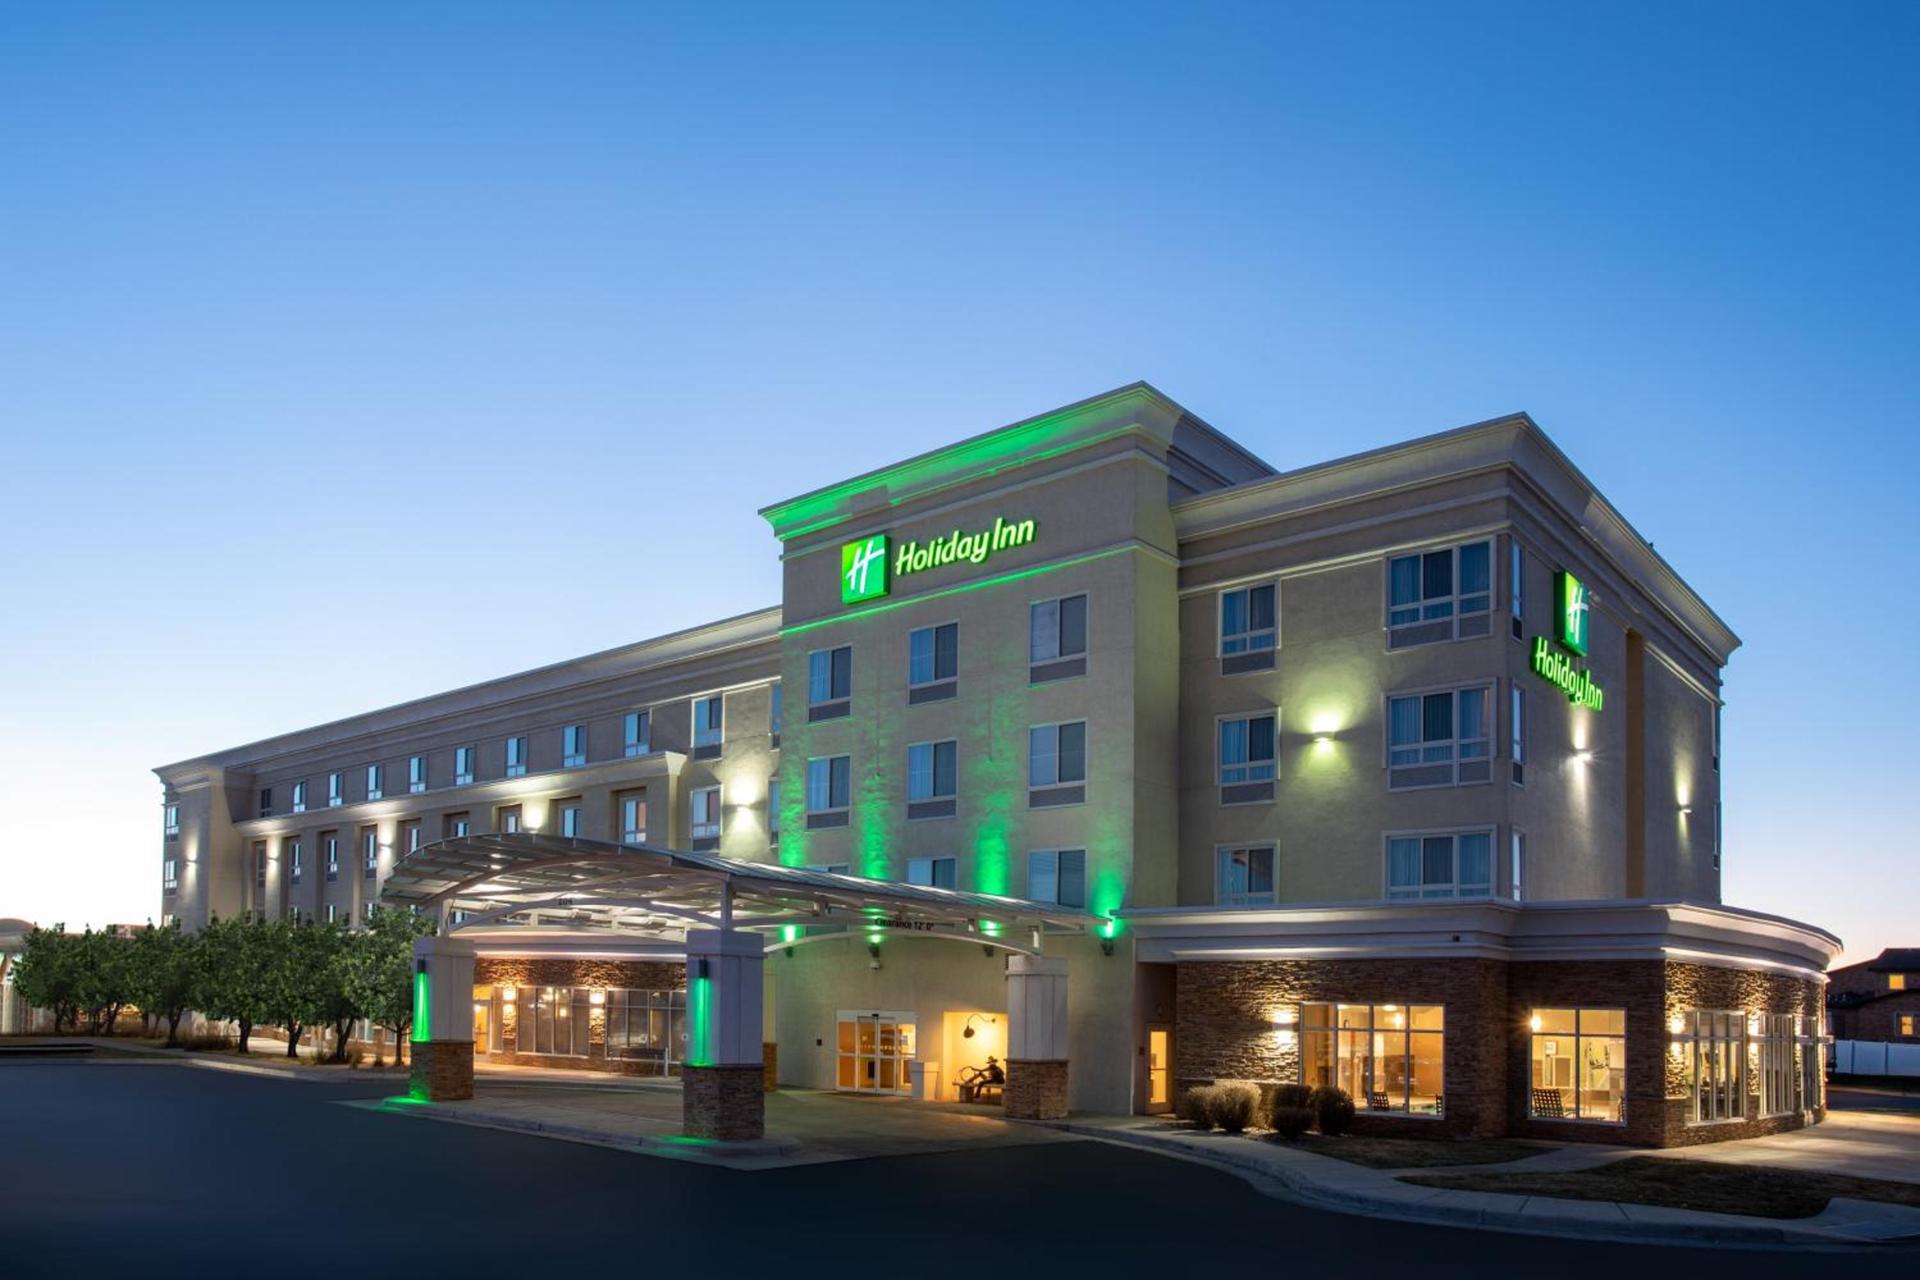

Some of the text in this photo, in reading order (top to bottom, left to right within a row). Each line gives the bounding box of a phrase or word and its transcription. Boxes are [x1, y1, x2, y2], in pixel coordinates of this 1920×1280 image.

[895, 517, 1034, 575] Holiday Inn
[1534, 635, 1603, 711] Holiday Inn
